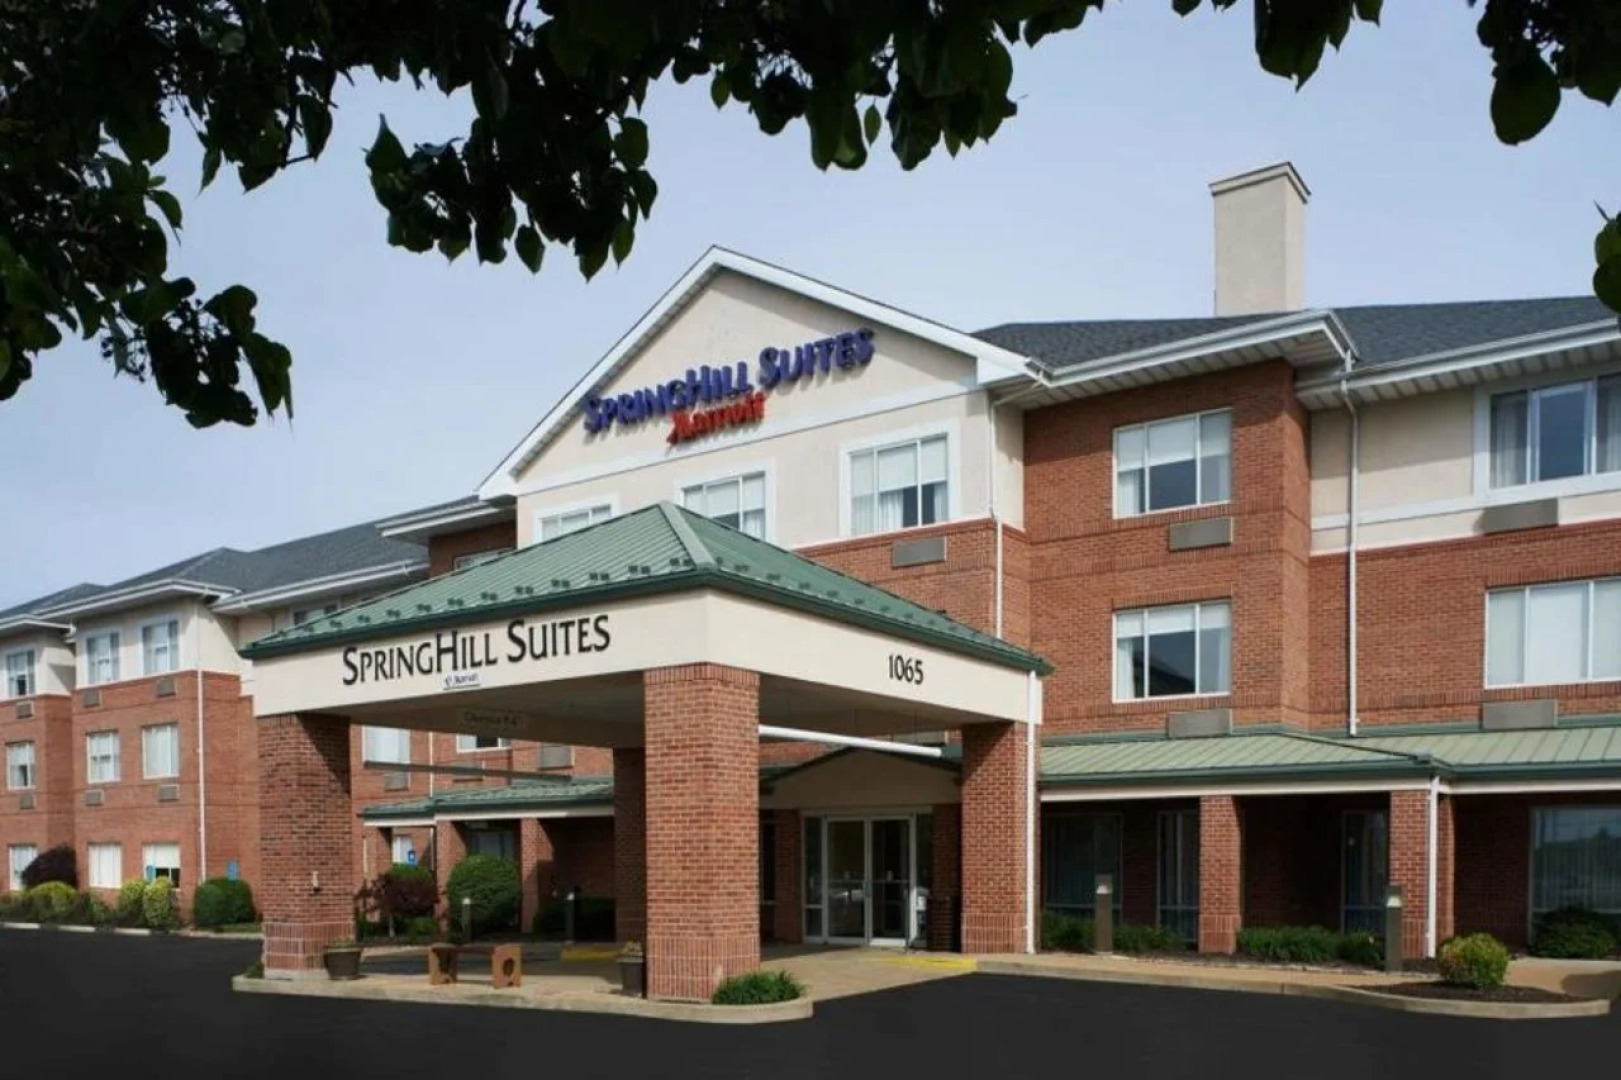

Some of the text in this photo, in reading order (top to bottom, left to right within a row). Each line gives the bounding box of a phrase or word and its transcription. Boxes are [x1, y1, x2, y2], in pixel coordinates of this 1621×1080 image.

[584, 327, 876, 433] SPRINGHILL SUITES
[342, 614, 611, 686] SPRINGHILL SUITES
[888, 654, 924, 686] 1065
